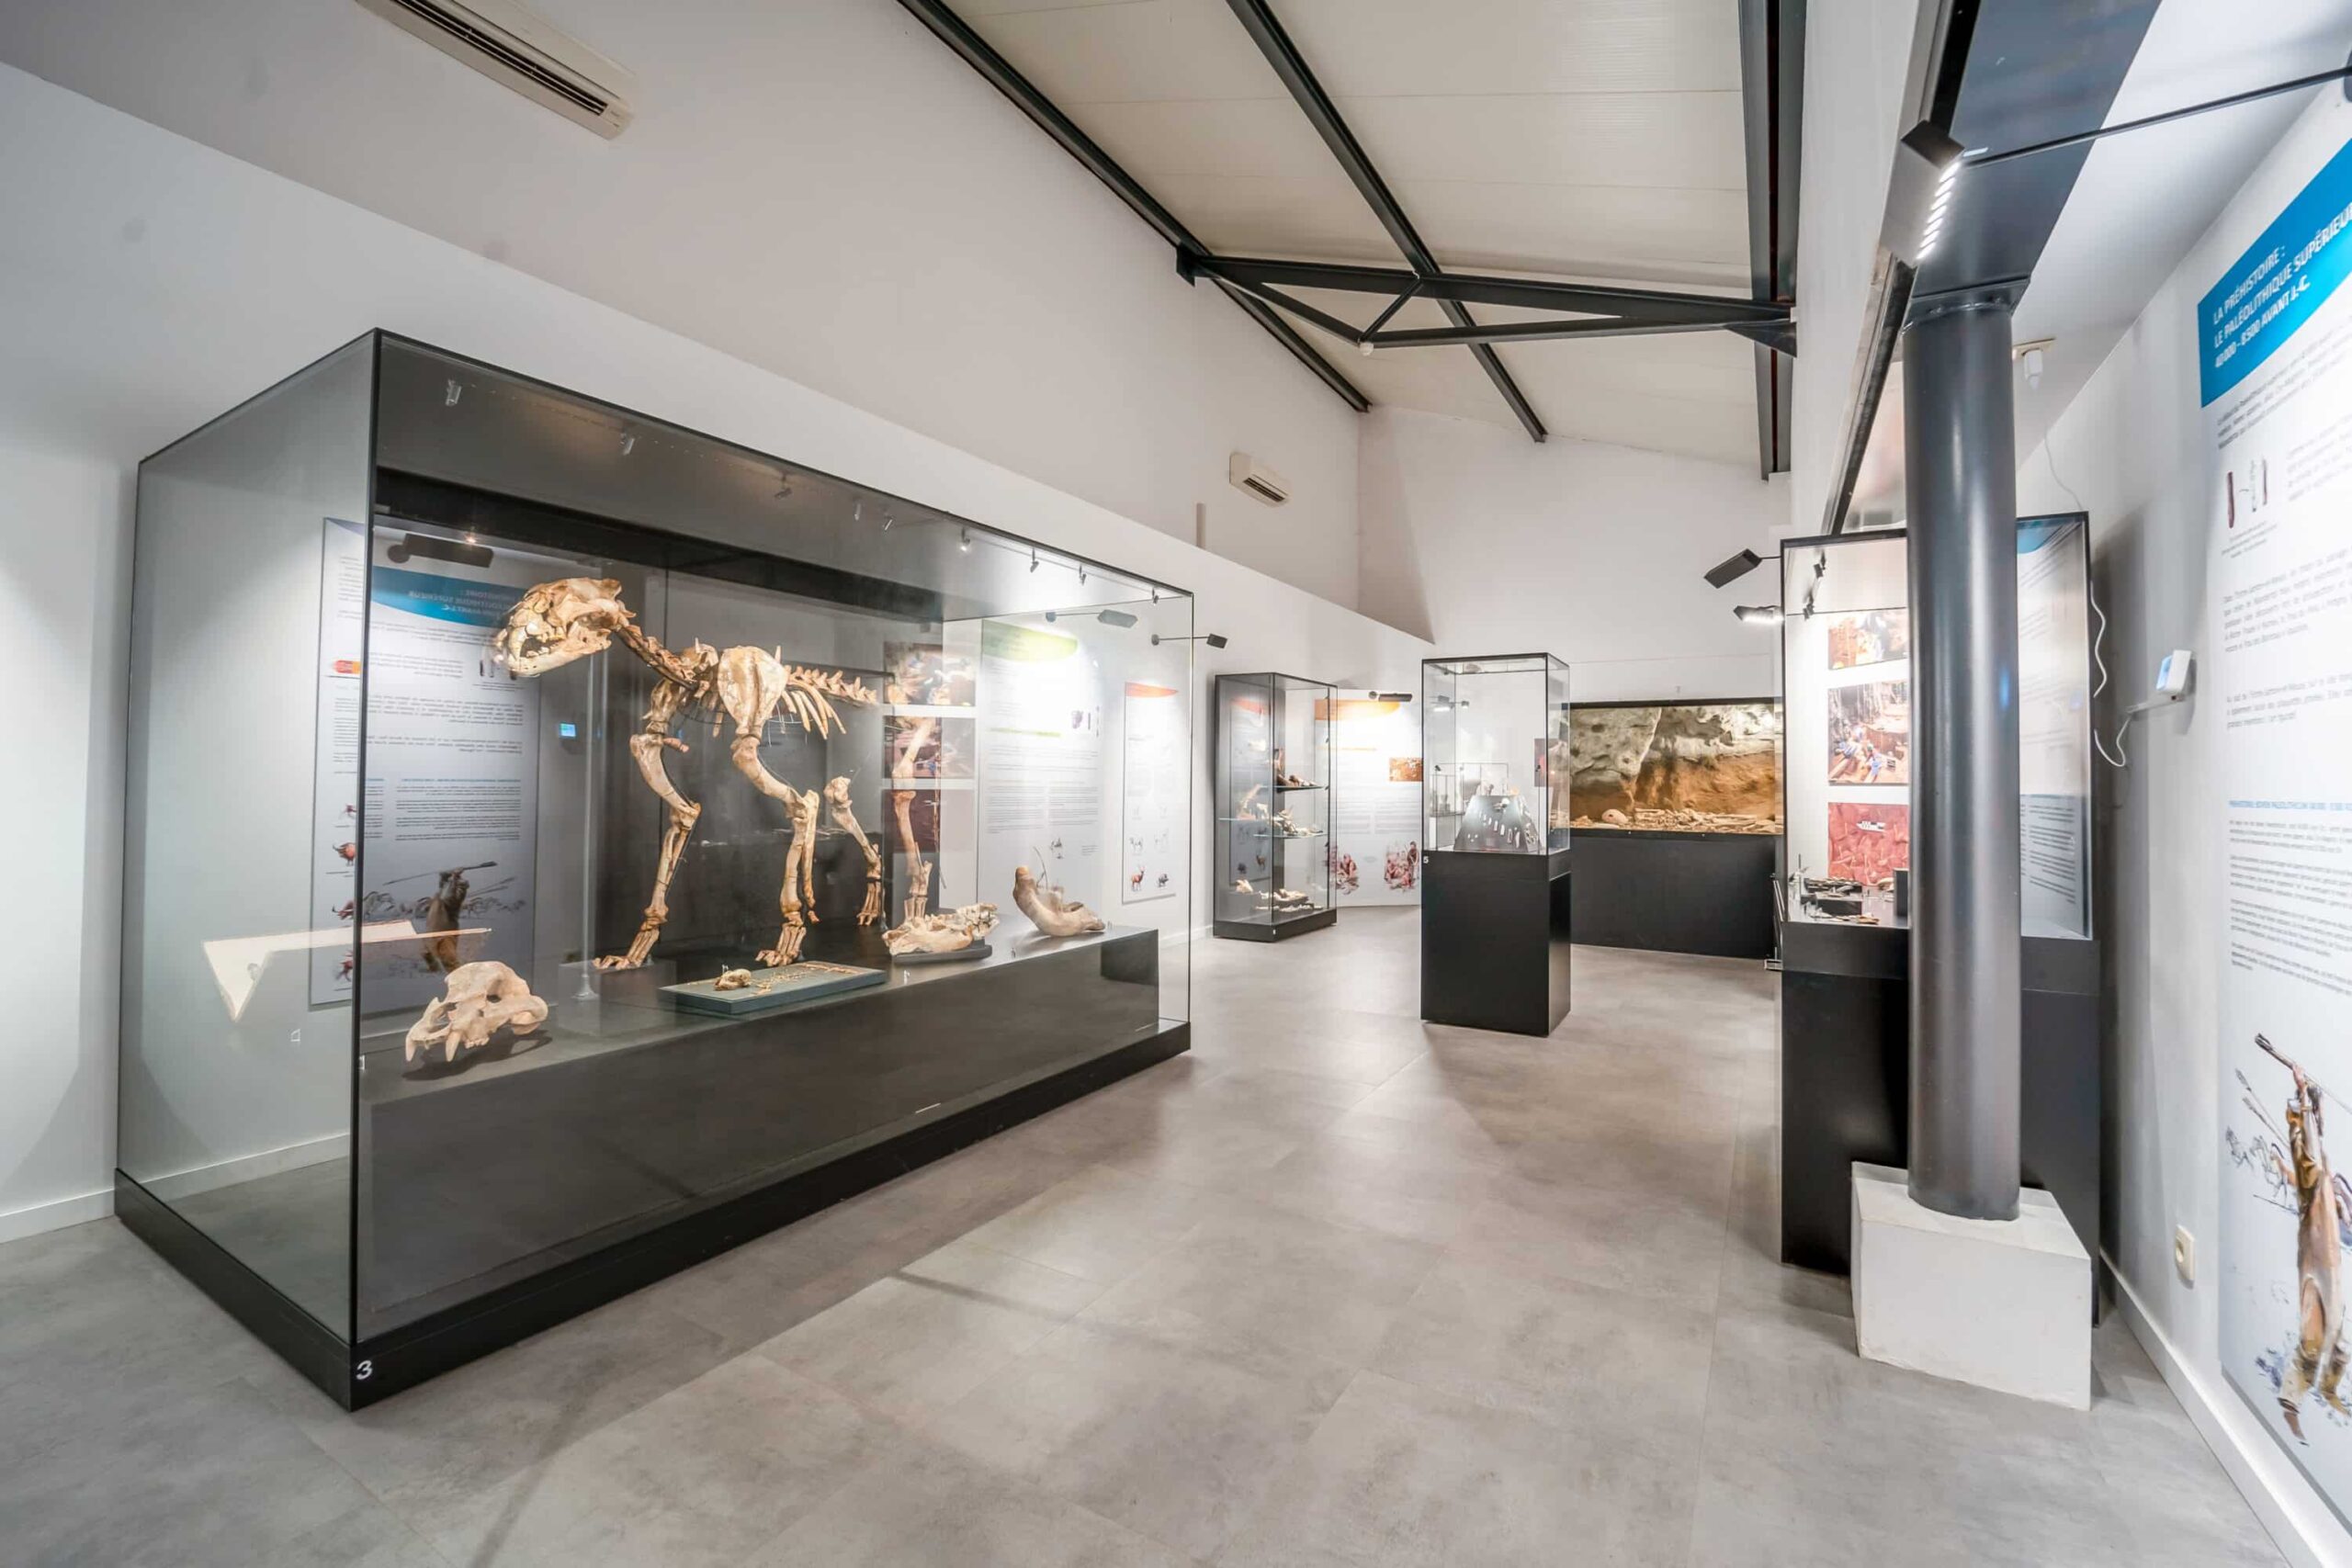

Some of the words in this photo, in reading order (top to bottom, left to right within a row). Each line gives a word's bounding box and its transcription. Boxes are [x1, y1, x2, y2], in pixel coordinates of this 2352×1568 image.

[2213, 306, 2224, 325] LA
[2224, 248, 2279, 313] PRÉHISTOIRE
[2214, 330, 2224, 349] LE
[2224, 262, 2292, 339] PALÉOLITHIQUE
[2261, 290, 2290, 329] AVANT
[356, 1359, 373, 1381] 3
